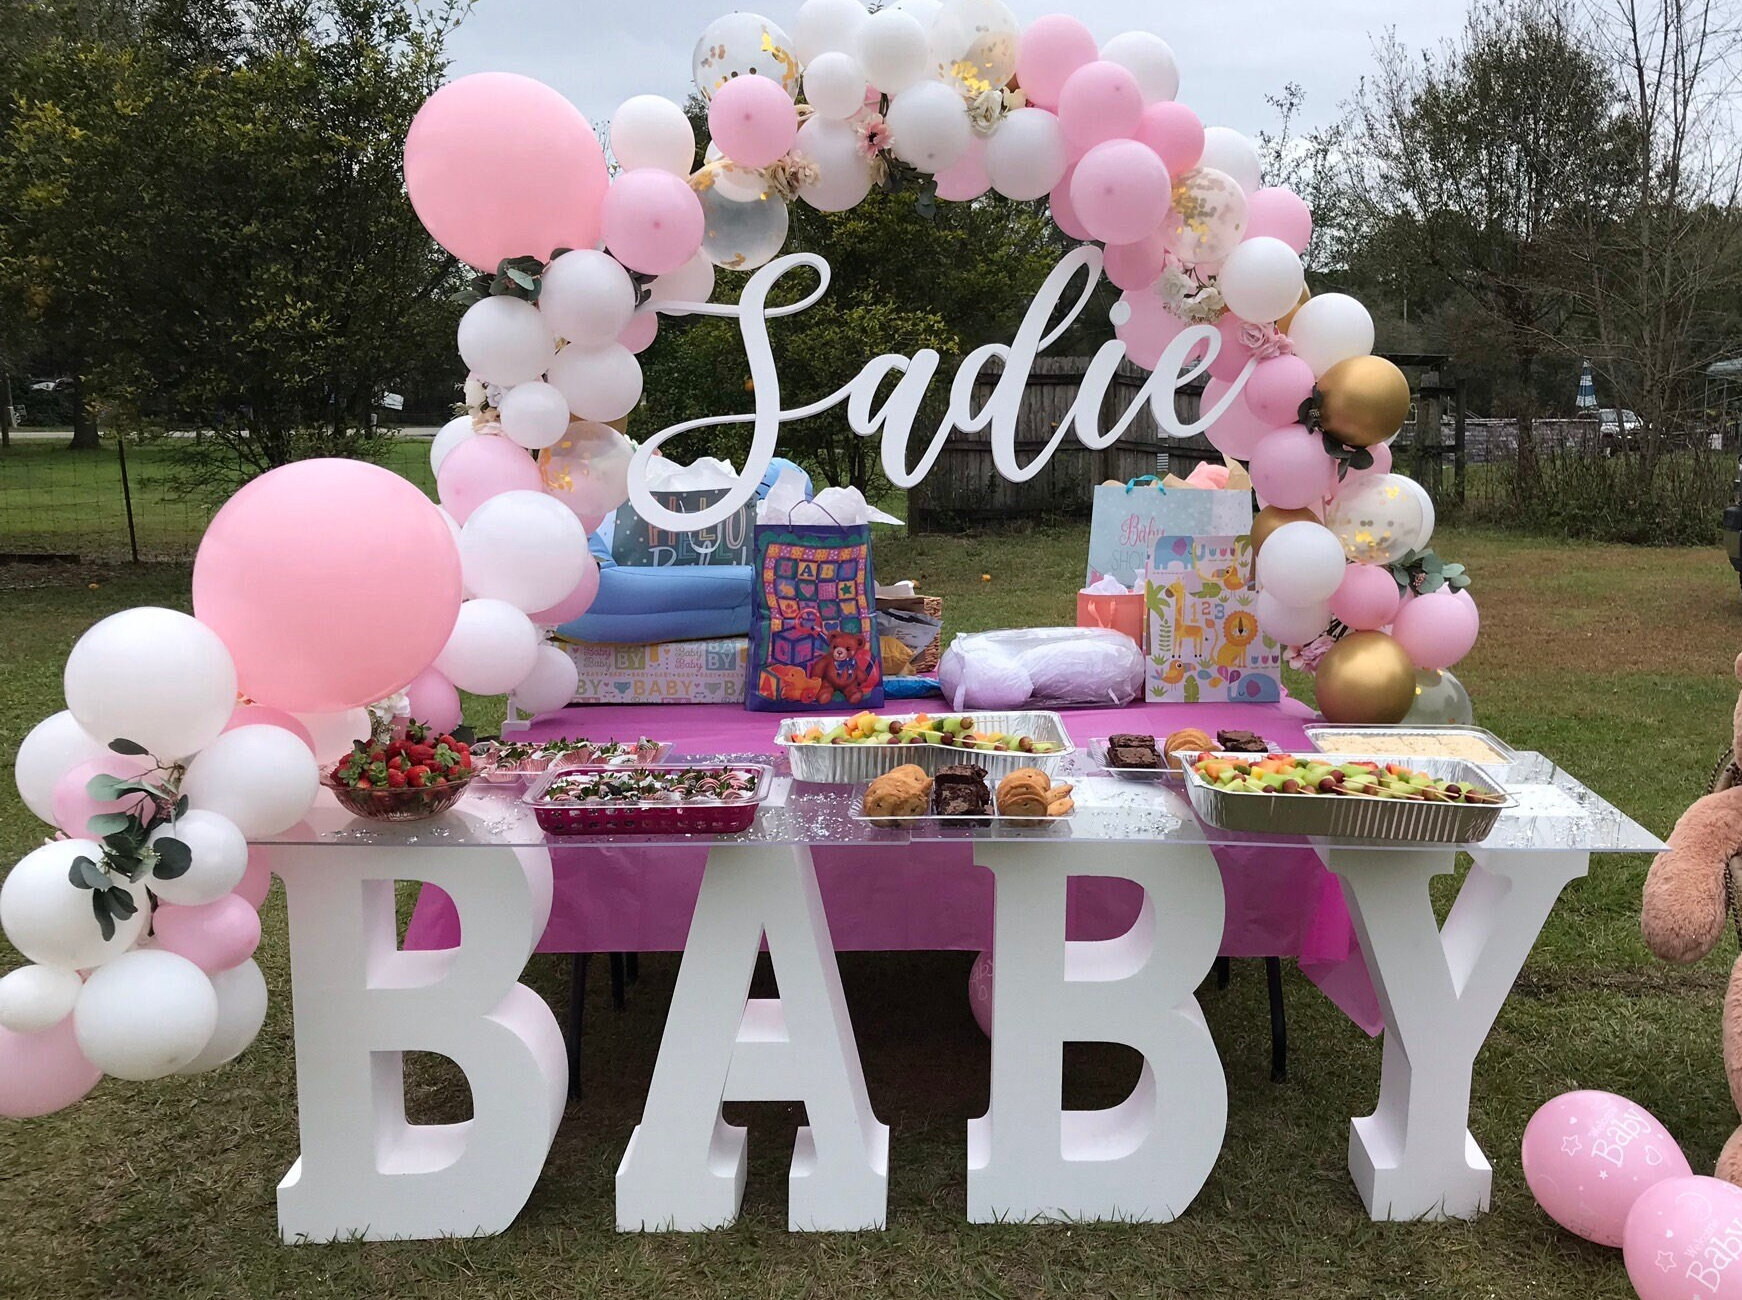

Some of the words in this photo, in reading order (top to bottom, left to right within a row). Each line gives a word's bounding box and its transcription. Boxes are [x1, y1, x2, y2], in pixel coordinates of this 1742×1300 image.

[627, 245, 1259, 531] Sadie
[780, 560, 853, 579] BABY
[1111, 548, 1145, 571] SHO
[674, 658, 703, 673] Baby
[634, 679, 693, 696] BABY
[270, 843, 1588, 1245] BABY
[1591, 1108, 1652, 1168] Baby
